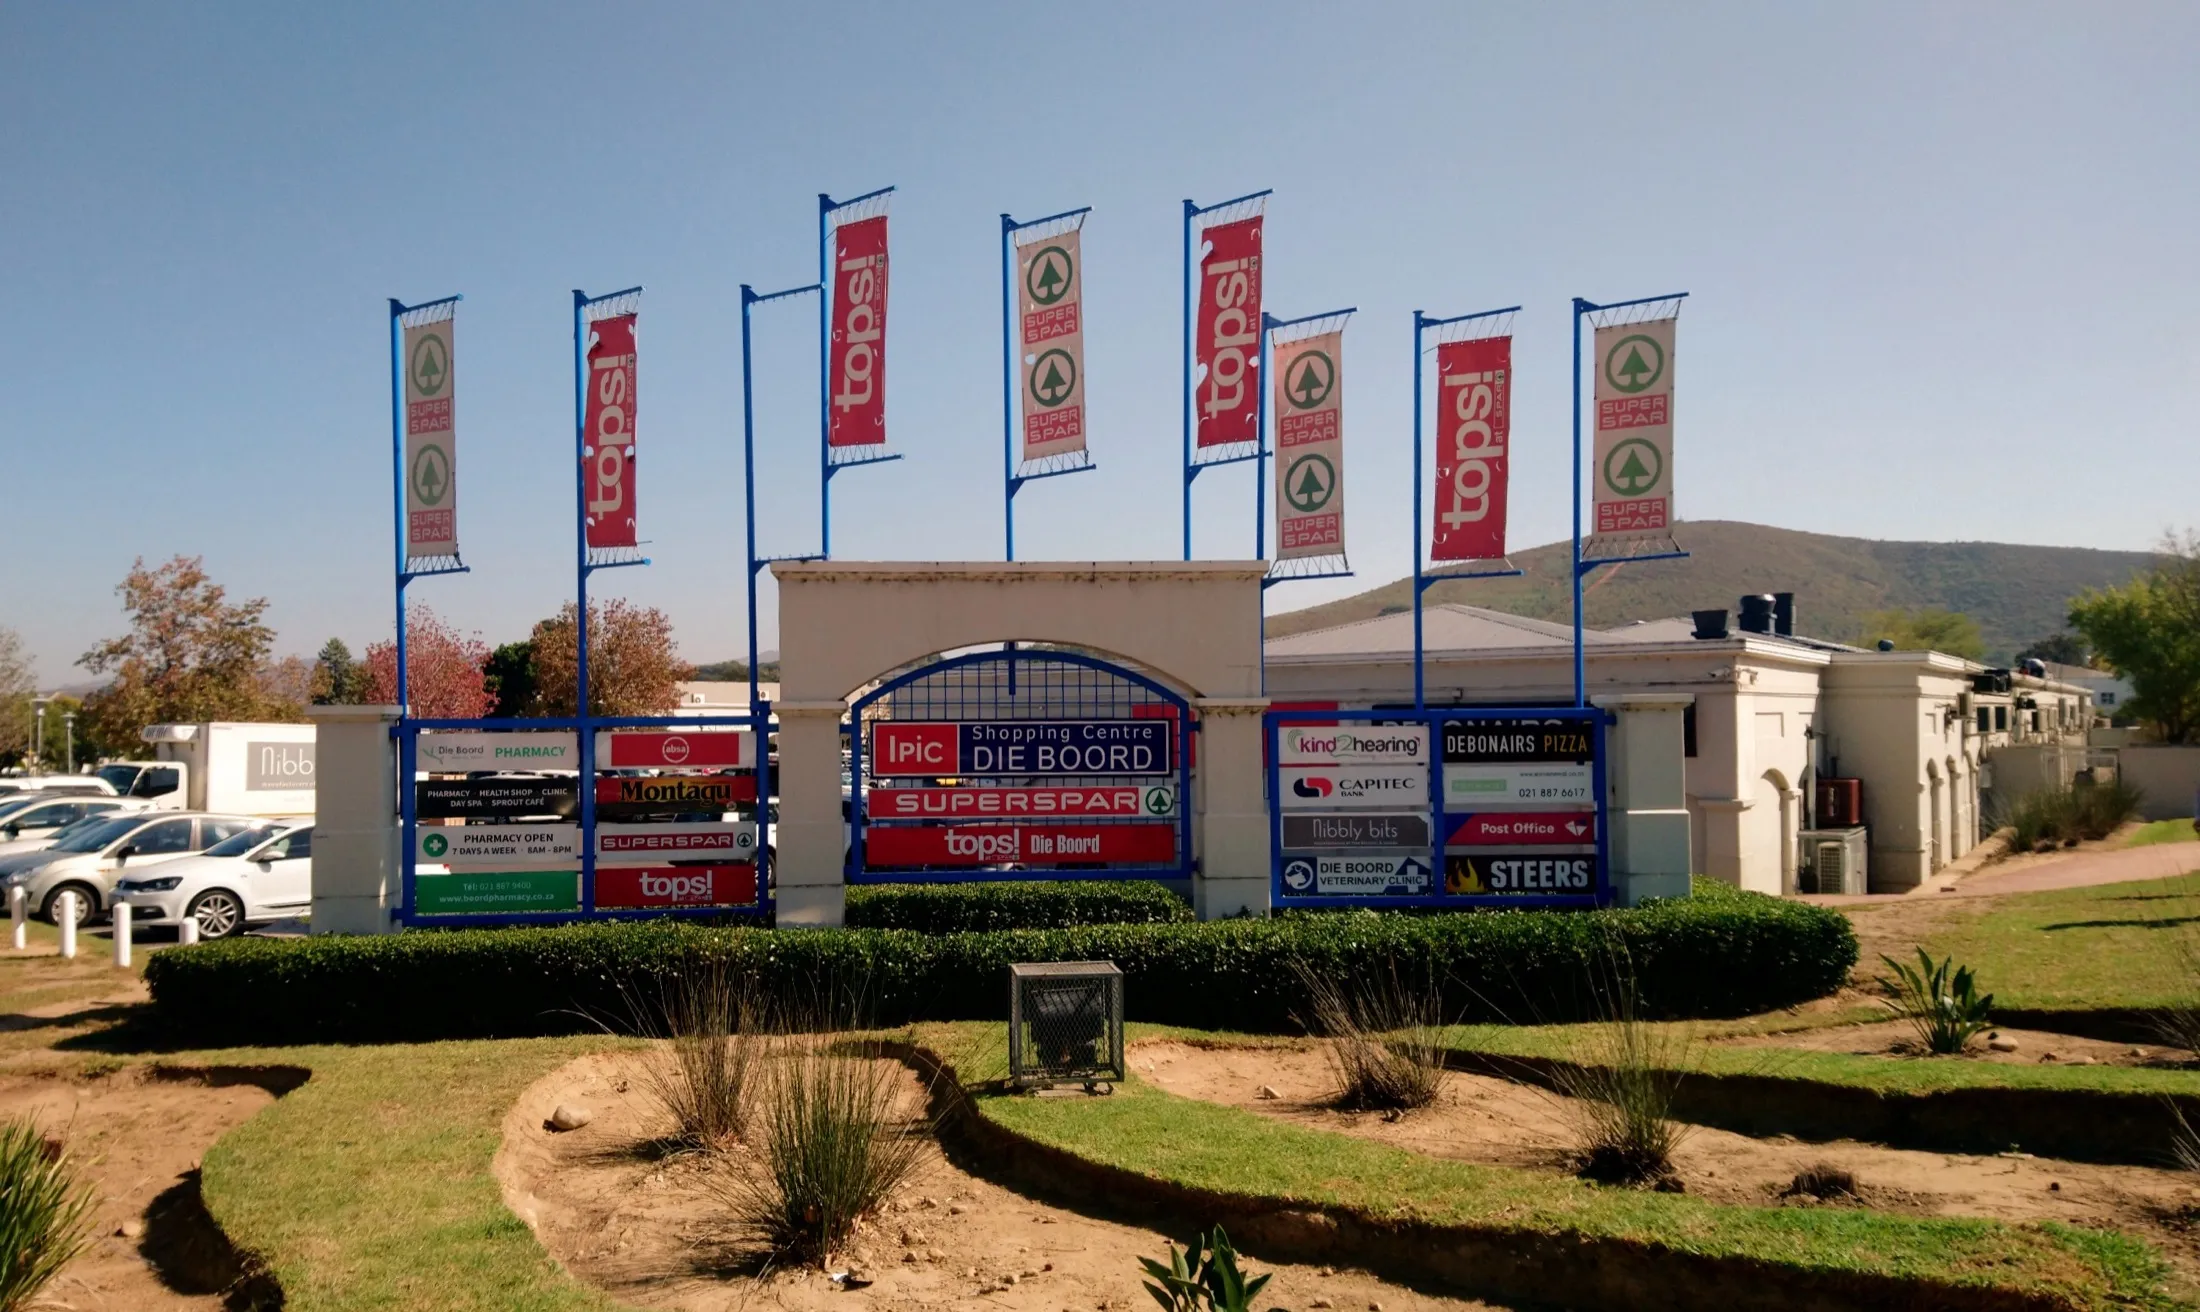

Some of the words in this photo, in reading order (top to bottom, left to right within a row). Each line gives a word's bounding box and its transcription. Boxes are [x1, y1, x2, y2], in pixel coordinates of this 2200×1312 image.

[1026, 306, 1076, 327] SUPER
[834, 254, 881, 413] tops!
[1027, 321, 1076, 341] SPAR
[1205, 258, 1257, 419] tops!
[411, 401, 448, 418] SUPER
[1495, 384, 1504, 418] SPAR
[1603, 397, 1665, 415] SUPER
[411, 416, 449, 432] SPAR
[1029, 409, 1078, 428] SUPER
[1283, 412, 1335, 432] SUPER
[1602, 411, 1664, 428] SPAR
[589, 354, 632, 520] tops!
[1030, 424, 1078, 442] SPAR
[1283, 426, 1335, 445] SPAR
[1441, 370, 1503, 530] tops!
[1601, 501, 1663, 516] SUPER
[411, 512, 450, 527] SUPER
[1284, 517, 1336, 533] SUPER
[1601, 515, 1663, 529] SPAR
[412, 525, 450, 541] SPAR
[1285, 530, 1337, 546] SPAR
[973, 726, 1070, 742] Shopping
[1083, 725, 1152, 739] Centre
[438, 746, 453, 754] Die
[456, 745, 484, 754] Boord
[495, 746, 566, 758] PHARMACY
[665, 744, 686, 753] absa
[1300, 735, 1418, 757] kind2hearing
[1447, 735, 1535, 753] DEBONAIRS
[1544, 735, 1588, 753] PIZZA
[974, 746, 1025, 770] DIE
[1038, 745, 1152, 770] BOORD
[1339, 778, 1415, 790] CAPITEC
[427, 790, 470, 798] PHARMACY
[511, 788, 532, 796] SHOP
[525, 797, 544, 806] CAFÉ
[621, 780, 731, 807] Montagu
[1519, 788, 1536, 798] 021
[1540, 788, 1558, 798] 887
[1561, 788, 1585, 798] 6617
[896, 792, 1136, 812] SUPERSPAR
[1313, 819, 1362, 840] Nibbly
[1369, 819, 1398, 838] bits
[1481, 823, 1509, 834] Post
[1513, 822, 1555, 834] Office
[464, 834, 522, 843] PHARMACY
[524, 833, 553, 842] OPEN
[603, 835, 731, 848] SUPERSPAR
[944, 828, 1019, 861] tops!
[1031, 835, 1053, 853] Die
[1057, 834, 1099, 853] Boord
[452, 847, 457, 855] 7
[459, 847, 482, 855] DAYS
[491, 846, 516, 854] WEEK
[527, 846, 546, 854] 8AM
[1320, 863, 1341, 873] DIE
[1345, 862, 1393, 873] BOORD
[1490, 860, 1588, 888] STEERS
[639, 870, 712, 901] tops!
[1320, 876, 1386, 885] VETERINARY
[1388, 876, 1422, 885] CLINIC
[439, 893, 554, 903] www.boordpharmacy.co.za
